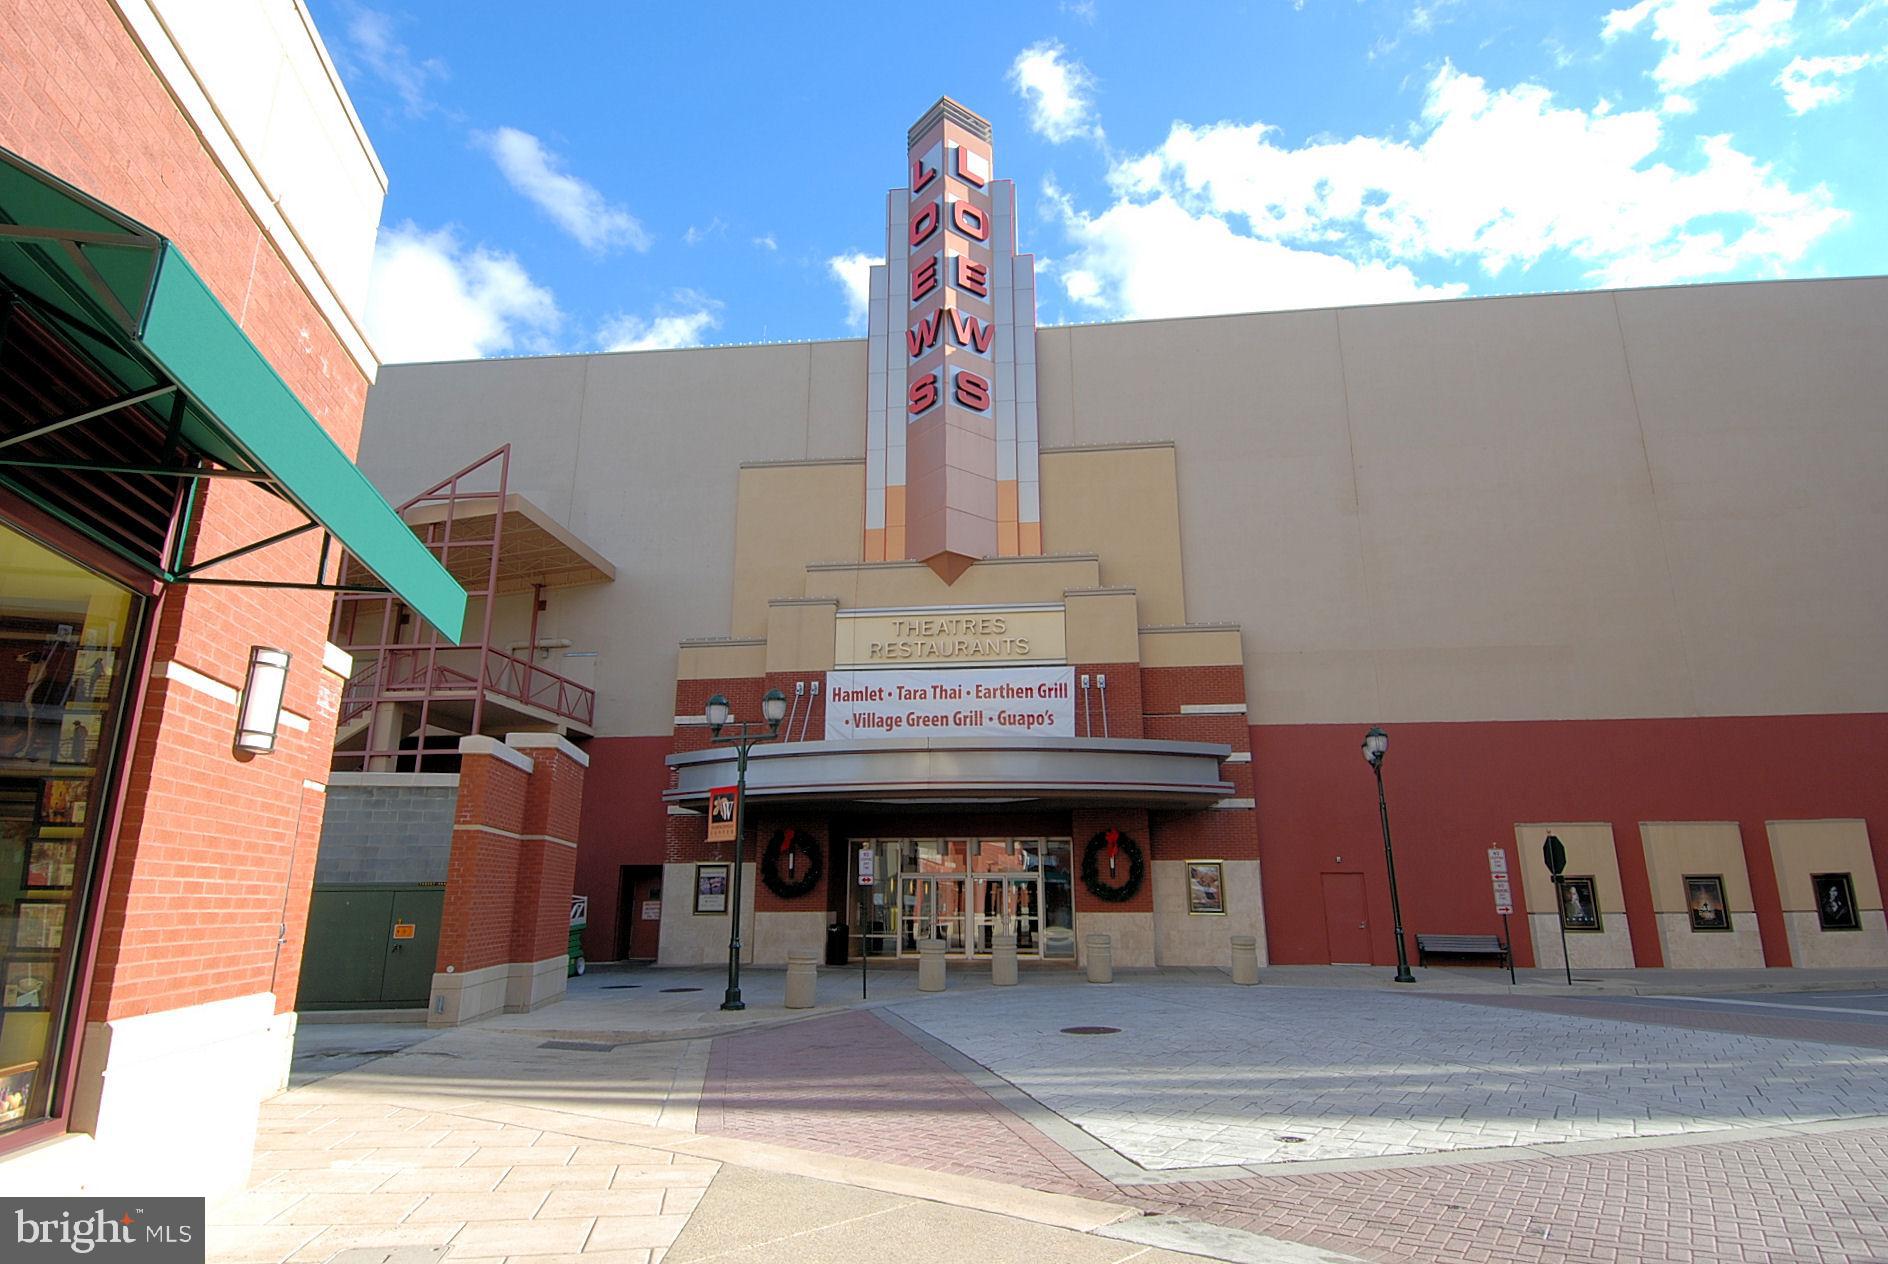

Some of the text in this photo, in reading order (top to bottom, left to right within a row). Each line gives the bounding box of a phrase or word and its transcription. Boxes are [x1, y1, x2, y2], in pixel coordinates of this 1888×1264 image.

[906, 159, 943, 415] LOEWS
[951, 145, 995, 412] LOEWS
[892, 617, 1007, 637] THEATRES
[869, 638, 1030, 659] RESTAURANTS
[832, 682, 1068, 702] Hamlet Tara Thai Earthen Grill
[853, 712, 902, 732] Village
[906, 711, 949, 727] Green
[953, 710, 983, 726] Grill
